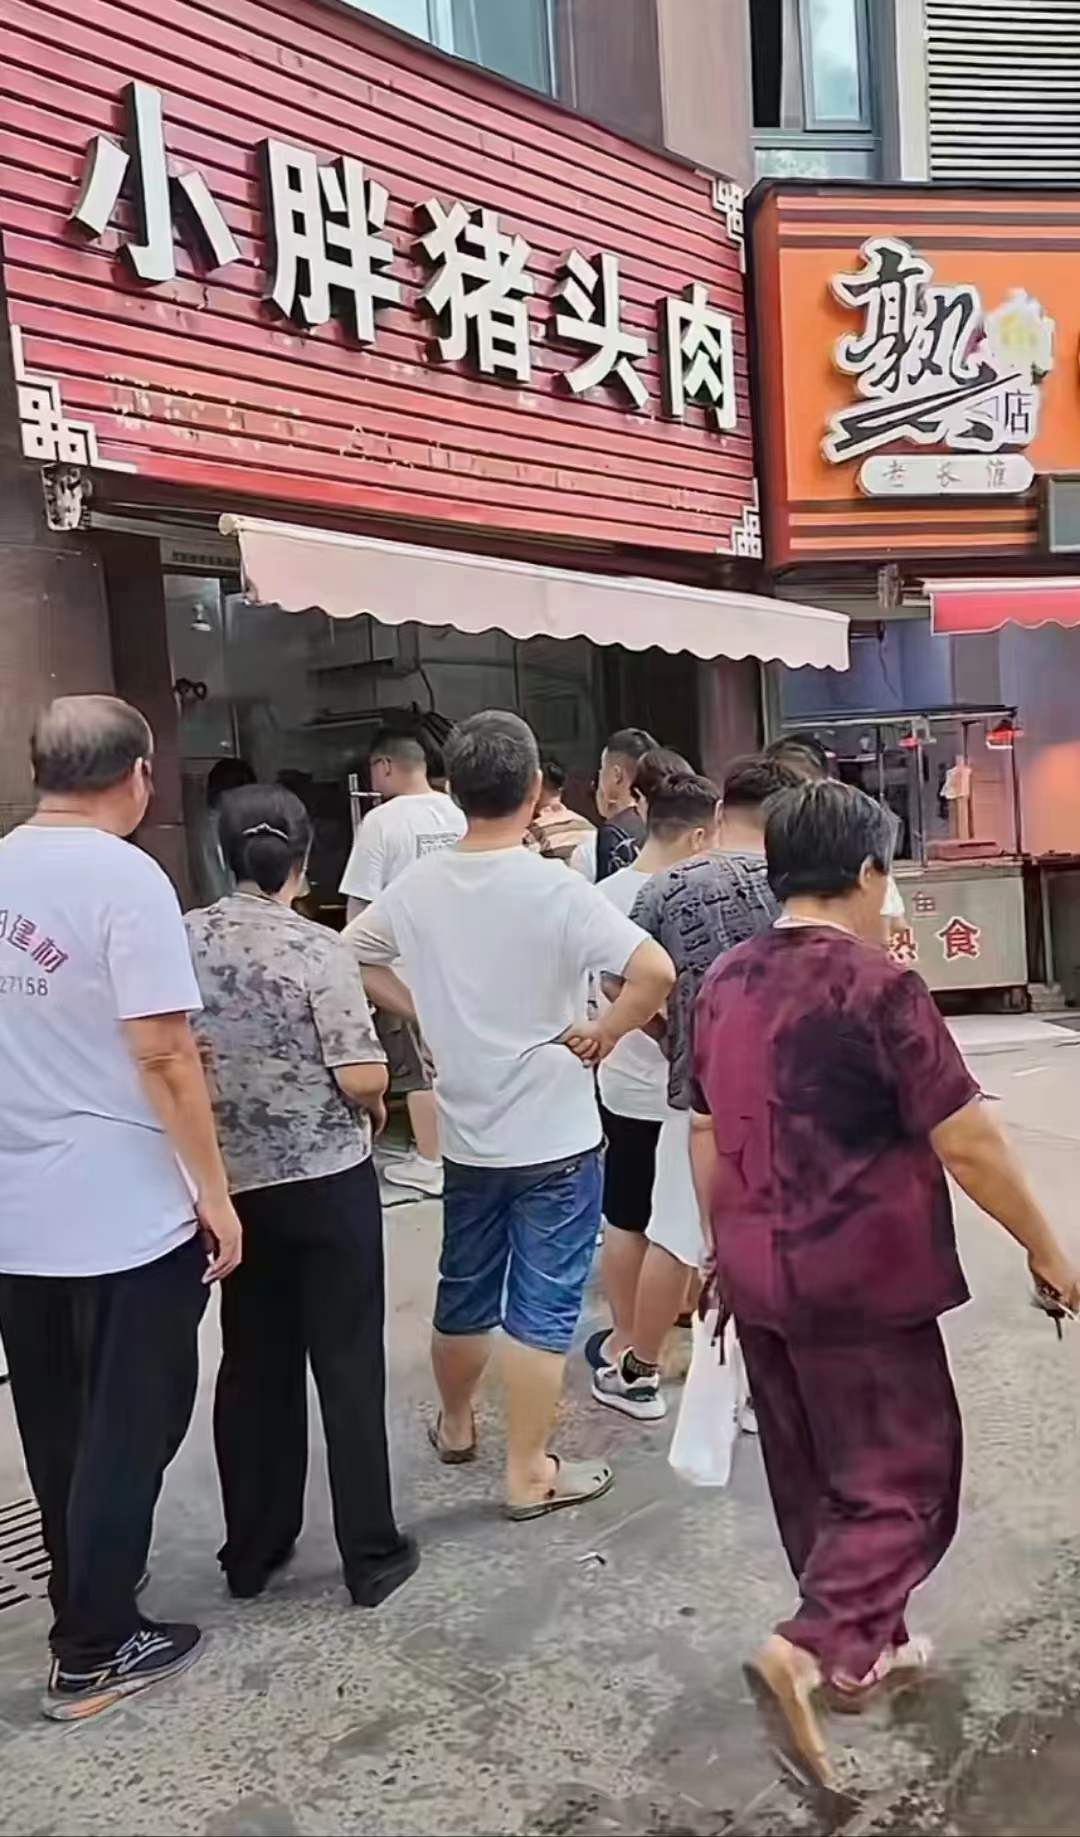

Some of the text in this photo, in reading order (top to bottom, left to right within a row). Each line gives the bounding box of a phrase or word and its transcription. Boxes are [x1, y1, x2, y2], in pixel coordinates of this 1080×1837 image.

[70, 81, 738, 432] 小胖猪头肉
